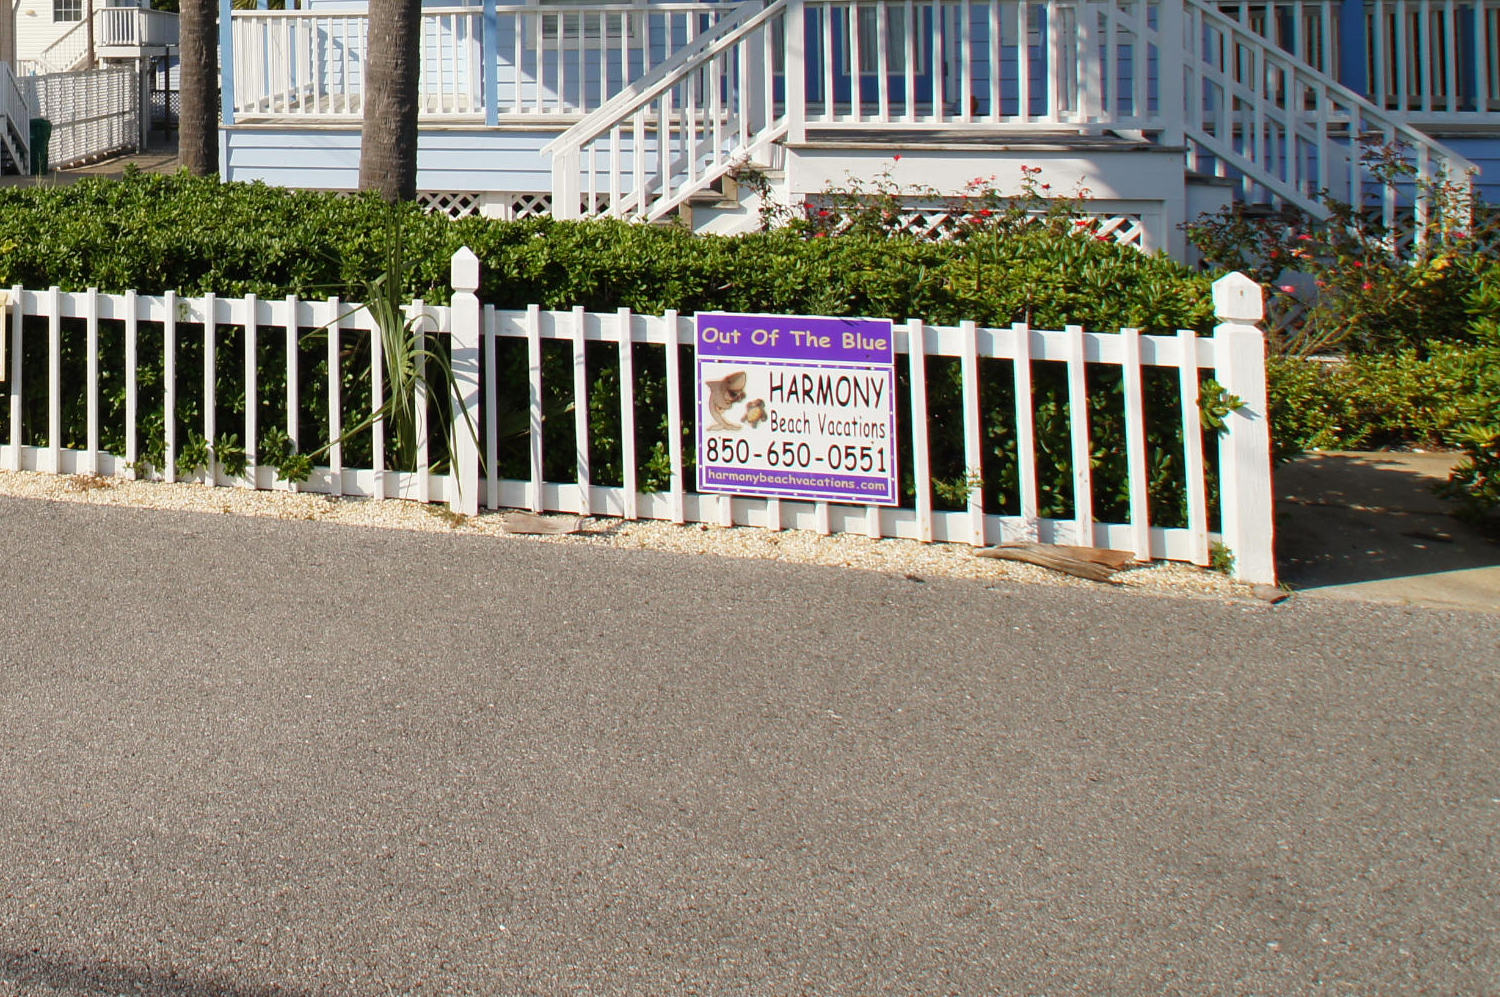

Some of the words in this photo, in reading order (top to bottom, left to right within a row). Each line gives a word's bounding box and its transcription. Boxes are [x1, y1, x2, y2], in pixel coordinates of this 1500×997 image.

[701, 327, 741, 344] Out
[750, 329, 780, 347] Of
[789, 330, 831, 348] The
[841, 332, 888, 350] Blue
[769, 371, 884, 409] HARMONY
[770, 410, 811, 435] Beach
[817, 413, 886, 439] Vacations
[706, 437, 887, 473] 850-650-0551
[707, 469, 887, 491] harmonybeachvacations.com
